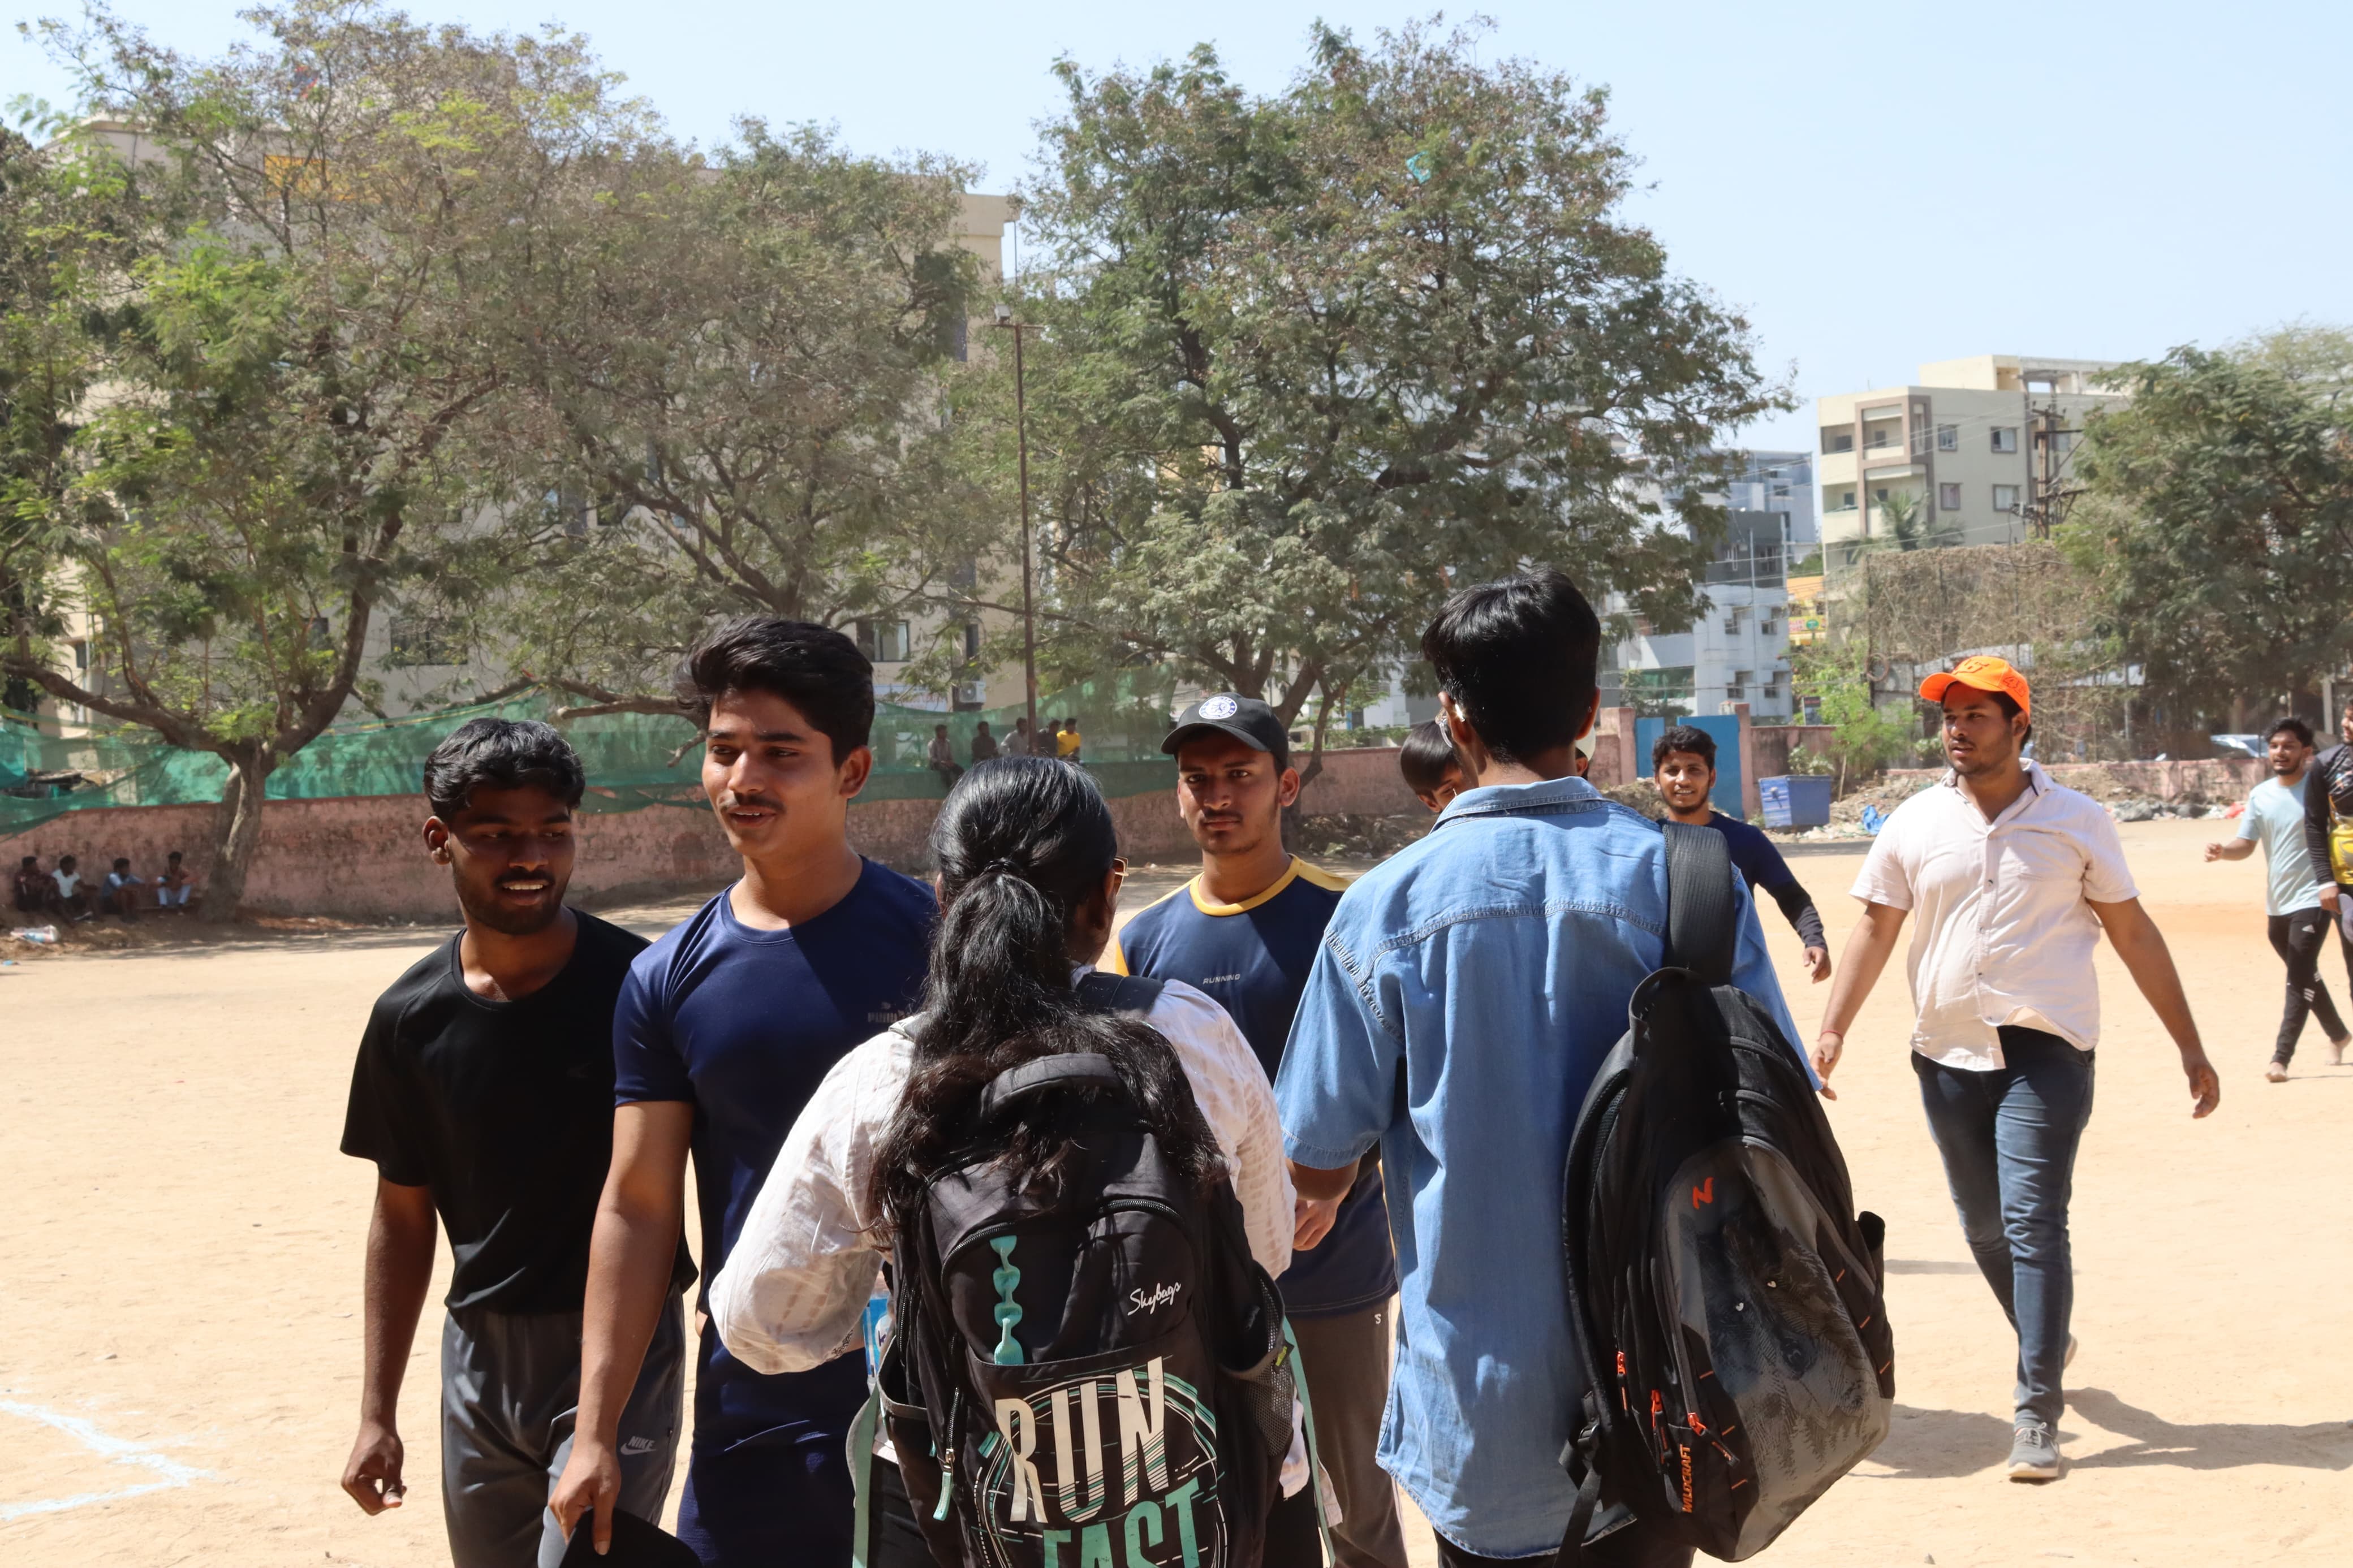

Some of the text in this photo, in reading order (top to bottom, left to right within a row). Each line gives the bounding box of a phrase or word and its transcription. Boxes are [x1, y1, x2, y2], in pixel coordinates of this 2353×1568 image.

[1203, 974, 1240, 984] RUNNING
[1127, 1282, 1182, 1316] Skybags
[628, 1436, 656, 1452] NIKE
[995, 1357, 1169, 1523] RUN
[1680, 1444, 1693, 1514] WILDCRAFT
